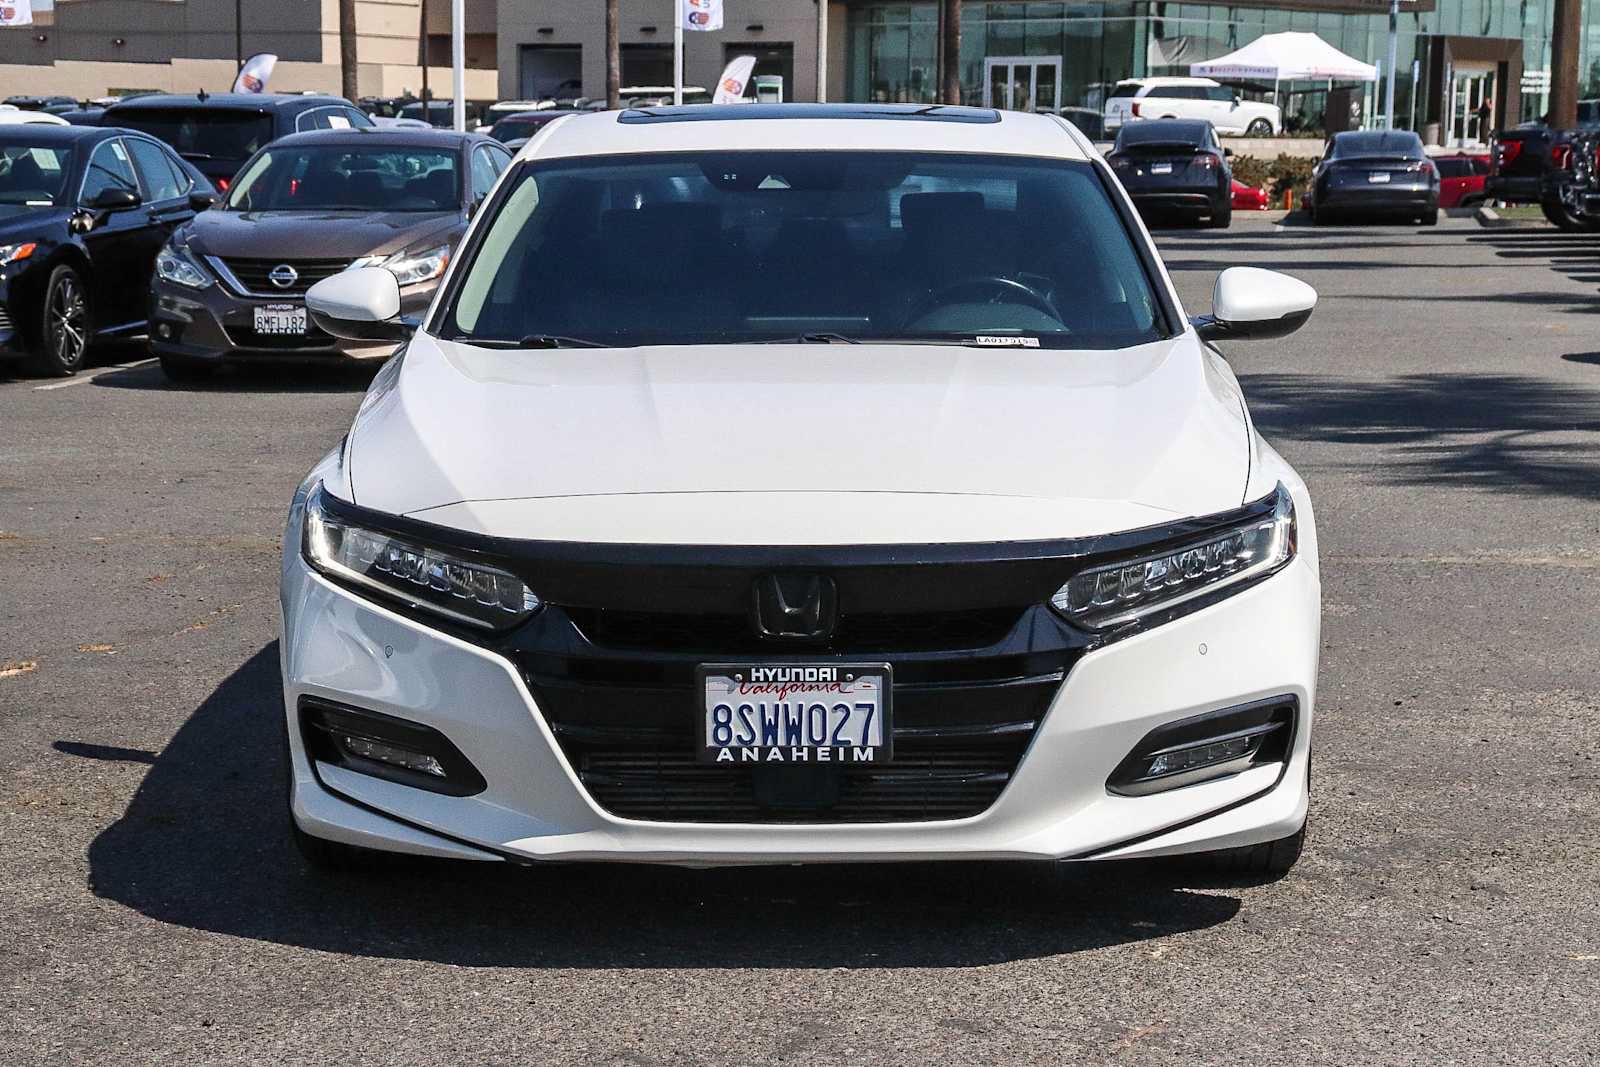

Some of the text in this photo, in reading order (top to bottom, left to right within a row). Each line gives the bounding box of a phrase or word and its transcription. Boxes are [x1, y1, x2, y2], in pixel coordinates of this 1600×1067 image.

[751, 667, 837, 682] HYUNDAI
[739, 681, 854, 700] California
[713, 703, 875, 746] 8SWW027
[716, 746, 875, 762] ANAHEIM
